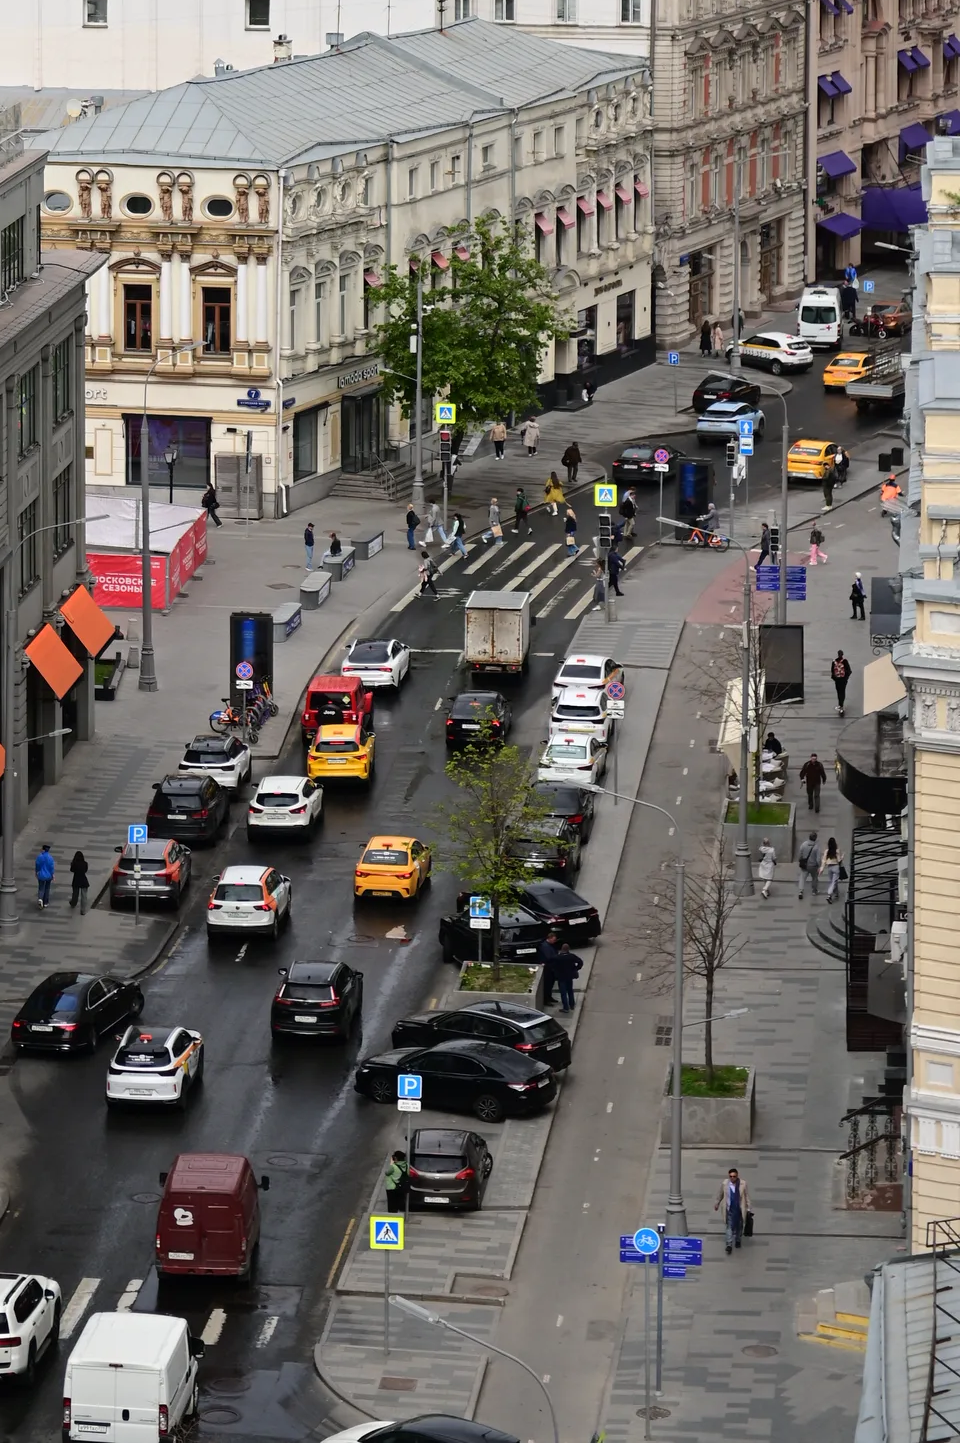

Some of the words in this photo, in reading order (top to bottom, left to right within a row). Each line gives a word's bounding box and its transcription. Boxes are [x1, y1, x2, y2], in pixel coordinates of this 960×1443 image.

[338, 370, 362, 388] lamoda
[85, 388, 107, 400] ort
[133, 827, 144, 842] P
[404, 1077, 418, 1096] P
